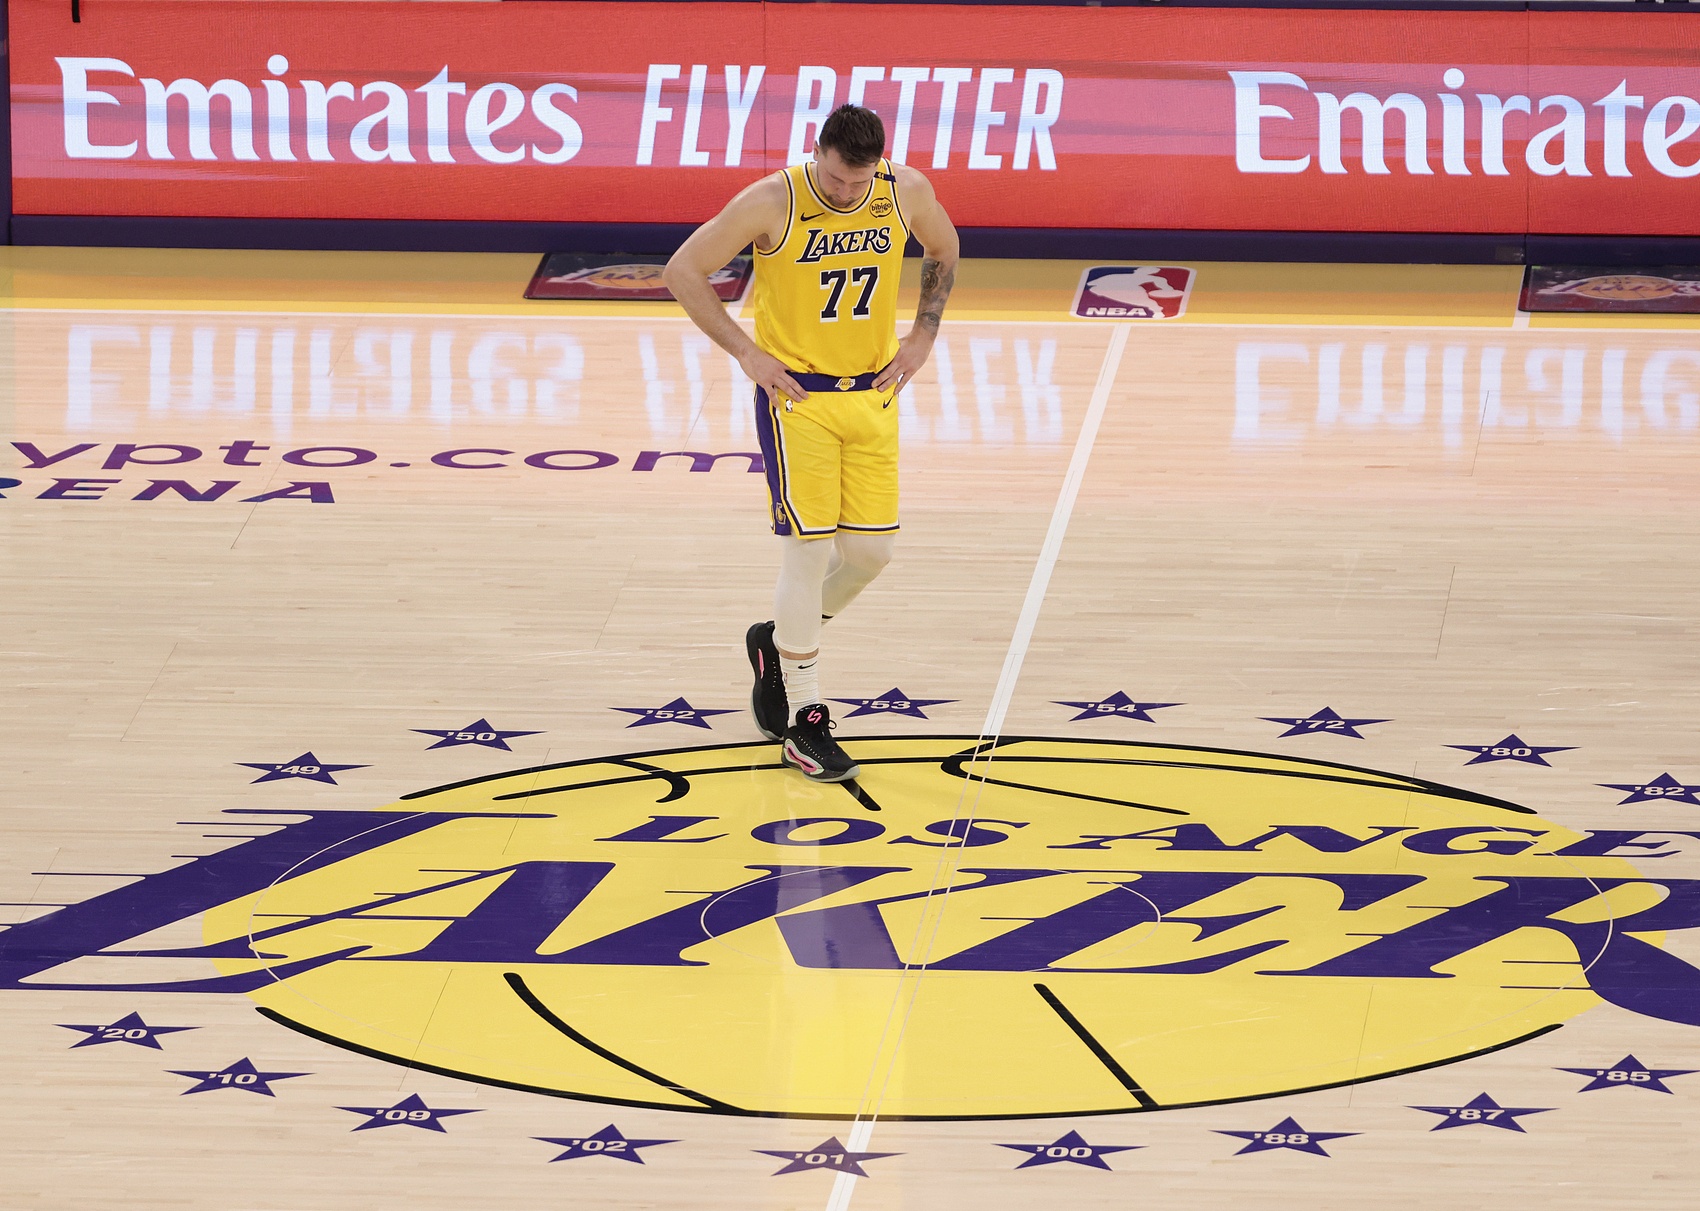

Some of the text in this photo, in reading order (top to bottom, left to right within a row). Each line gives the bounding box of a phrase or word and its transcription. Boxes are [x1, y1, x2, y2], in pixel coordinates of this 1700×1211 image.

[54, 54, 583, 164] Emirates
[636, 64, 766, 167] FLY
[1228, 68, 1700, 178] Emirate
[795, 227, 892, 264] LAKERS
[820, 266, 879, 322] 77
[1086, 307, 1147, 316] NBA
[862, 701, 911, 710] '53
[1087, 703, 1136, 712] '54
[646, 710, 695, 719] '52
[1295, 719, 1345, 729] '72
[448, 732, 497, 741] '50
[1481, 746, 1531, 757] '80
[275, 765, 320, 775] '49
[1635, 786, 1685, 796] '82
[593, 815, 1700, 858] LOS ANGE
[97, 1026, 148, 1039] '20
[208, 1073, 258, 1085] '10
[1597, 1070, 1651, 1082] '85
[377, 1109, 432, 1121] '09
[1449, 1109, 1504, 1121] '87
[1254, 1133, 1309, 1145] '88
[572, 1140, 628, 1152] '02
[1036, 1147, 1092, 1158] '00
[795, 1153, 845, 1165] '01
